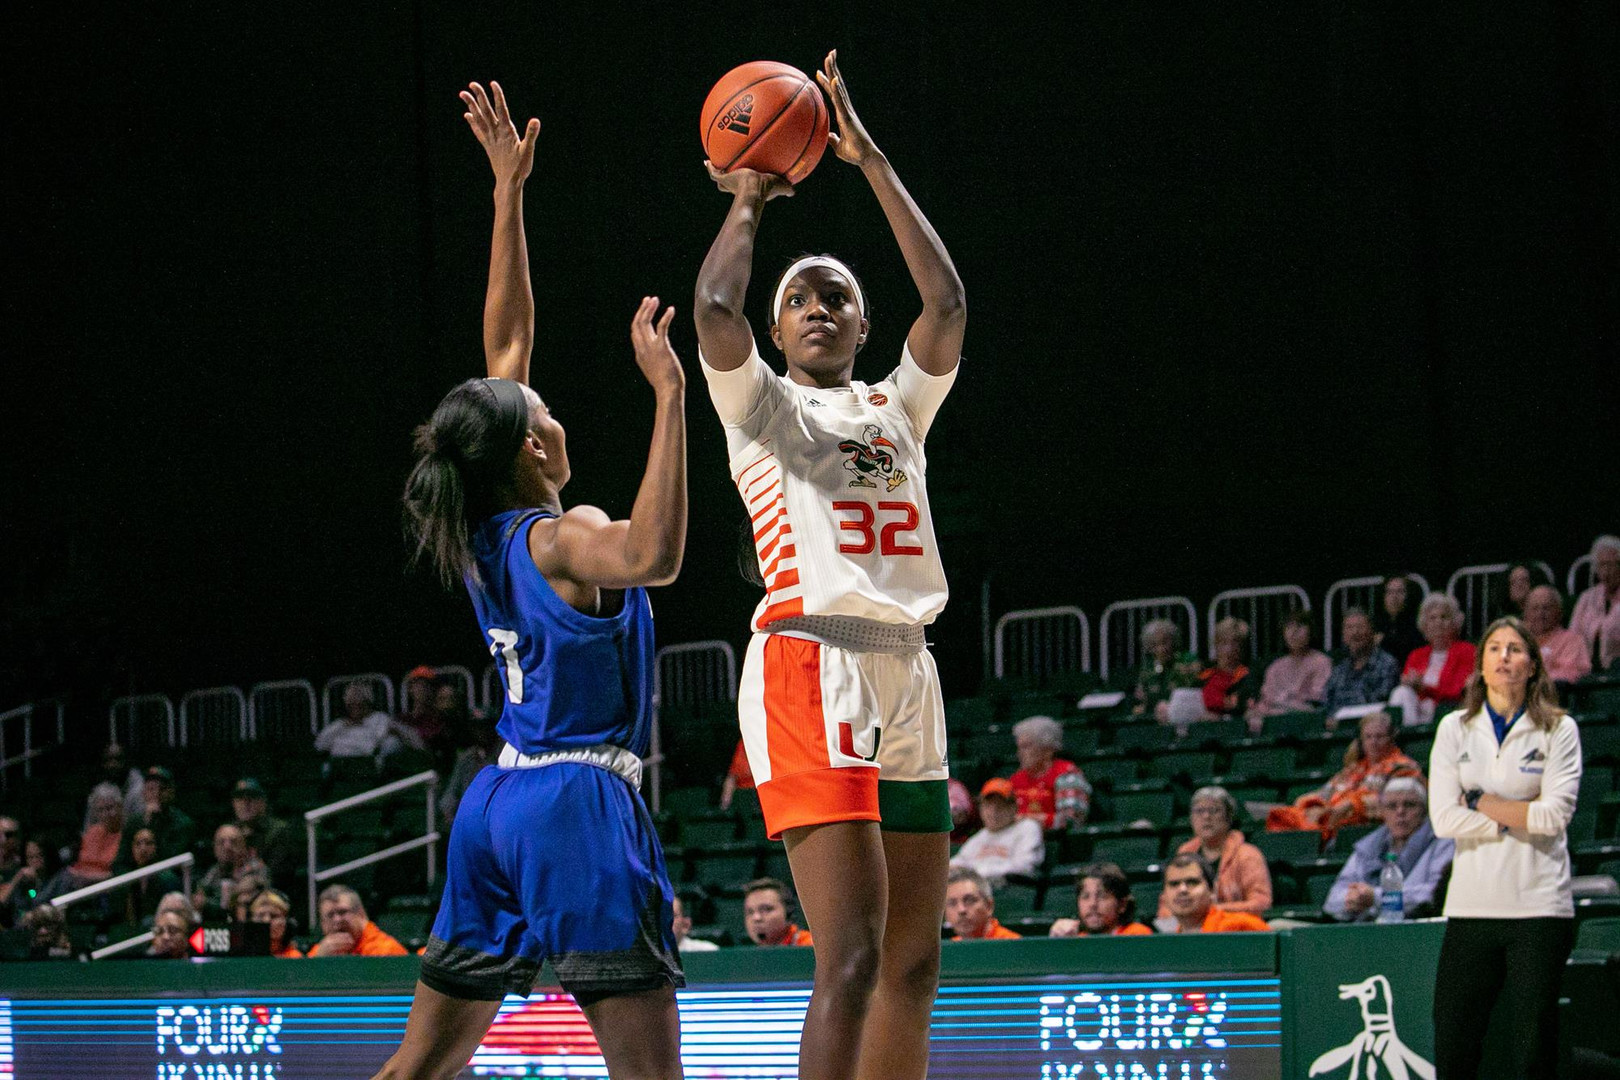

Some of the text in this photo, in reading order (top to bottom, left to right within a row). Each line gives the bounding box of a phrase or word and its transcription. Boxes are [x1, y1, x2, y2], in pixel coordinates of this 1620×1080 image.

[717, 93, 754, 131] adidas
[832, 500, 924, 557] 32
[204, 928, 230, 952] POSS
